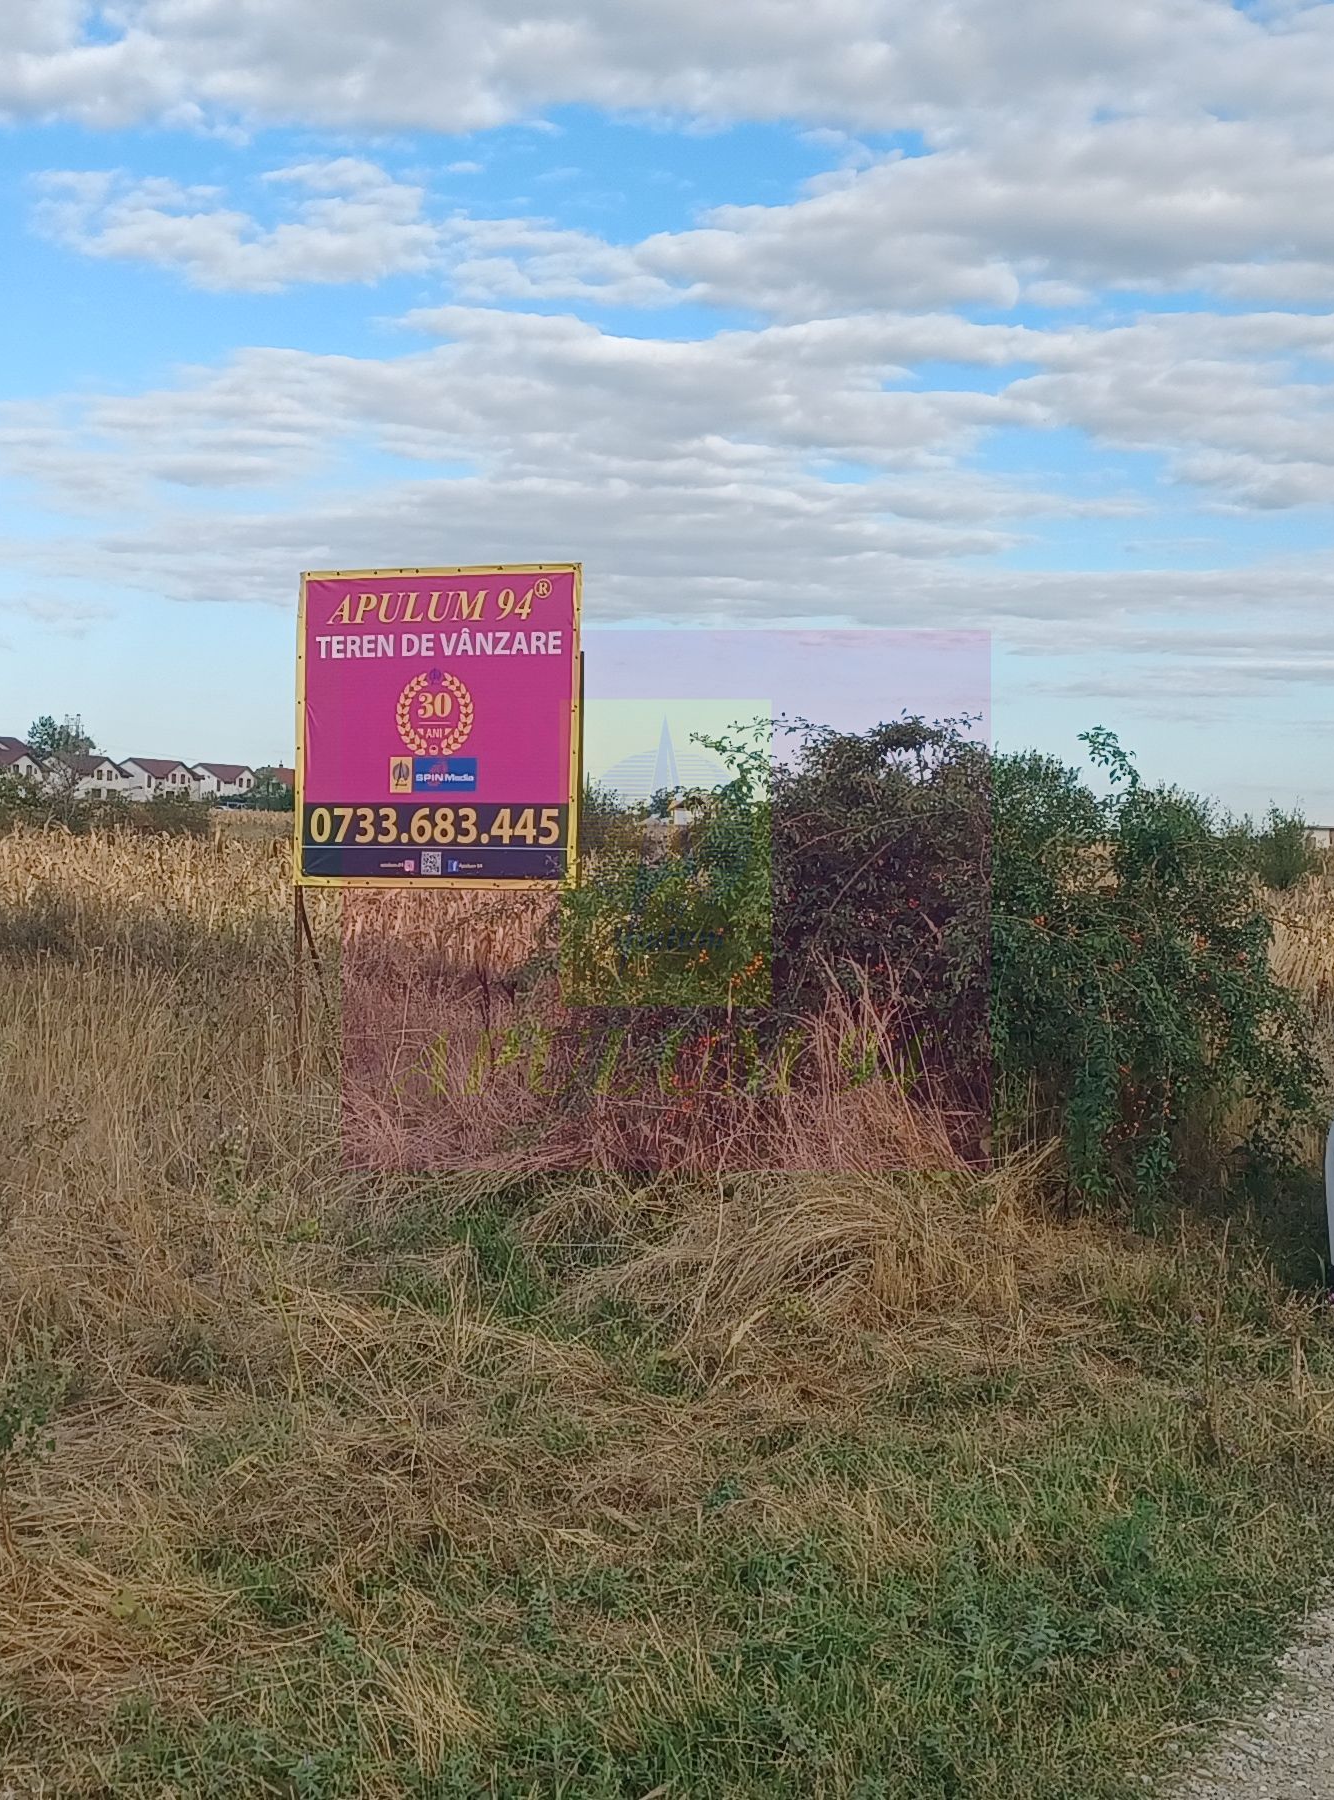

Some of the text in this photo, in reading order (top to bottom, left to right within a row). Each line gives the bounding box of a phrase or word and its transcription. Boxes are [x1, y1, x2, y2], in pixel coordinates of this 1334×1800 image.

[326, 590, 489, 625] APULUM
[315, 628, 562, 659] TEREN DE VÂNZARE
[417, 692, 452, 718] 30
[425, 727, 443, 738] ANI
[310, 807, 560, 844] 0733.683.445
